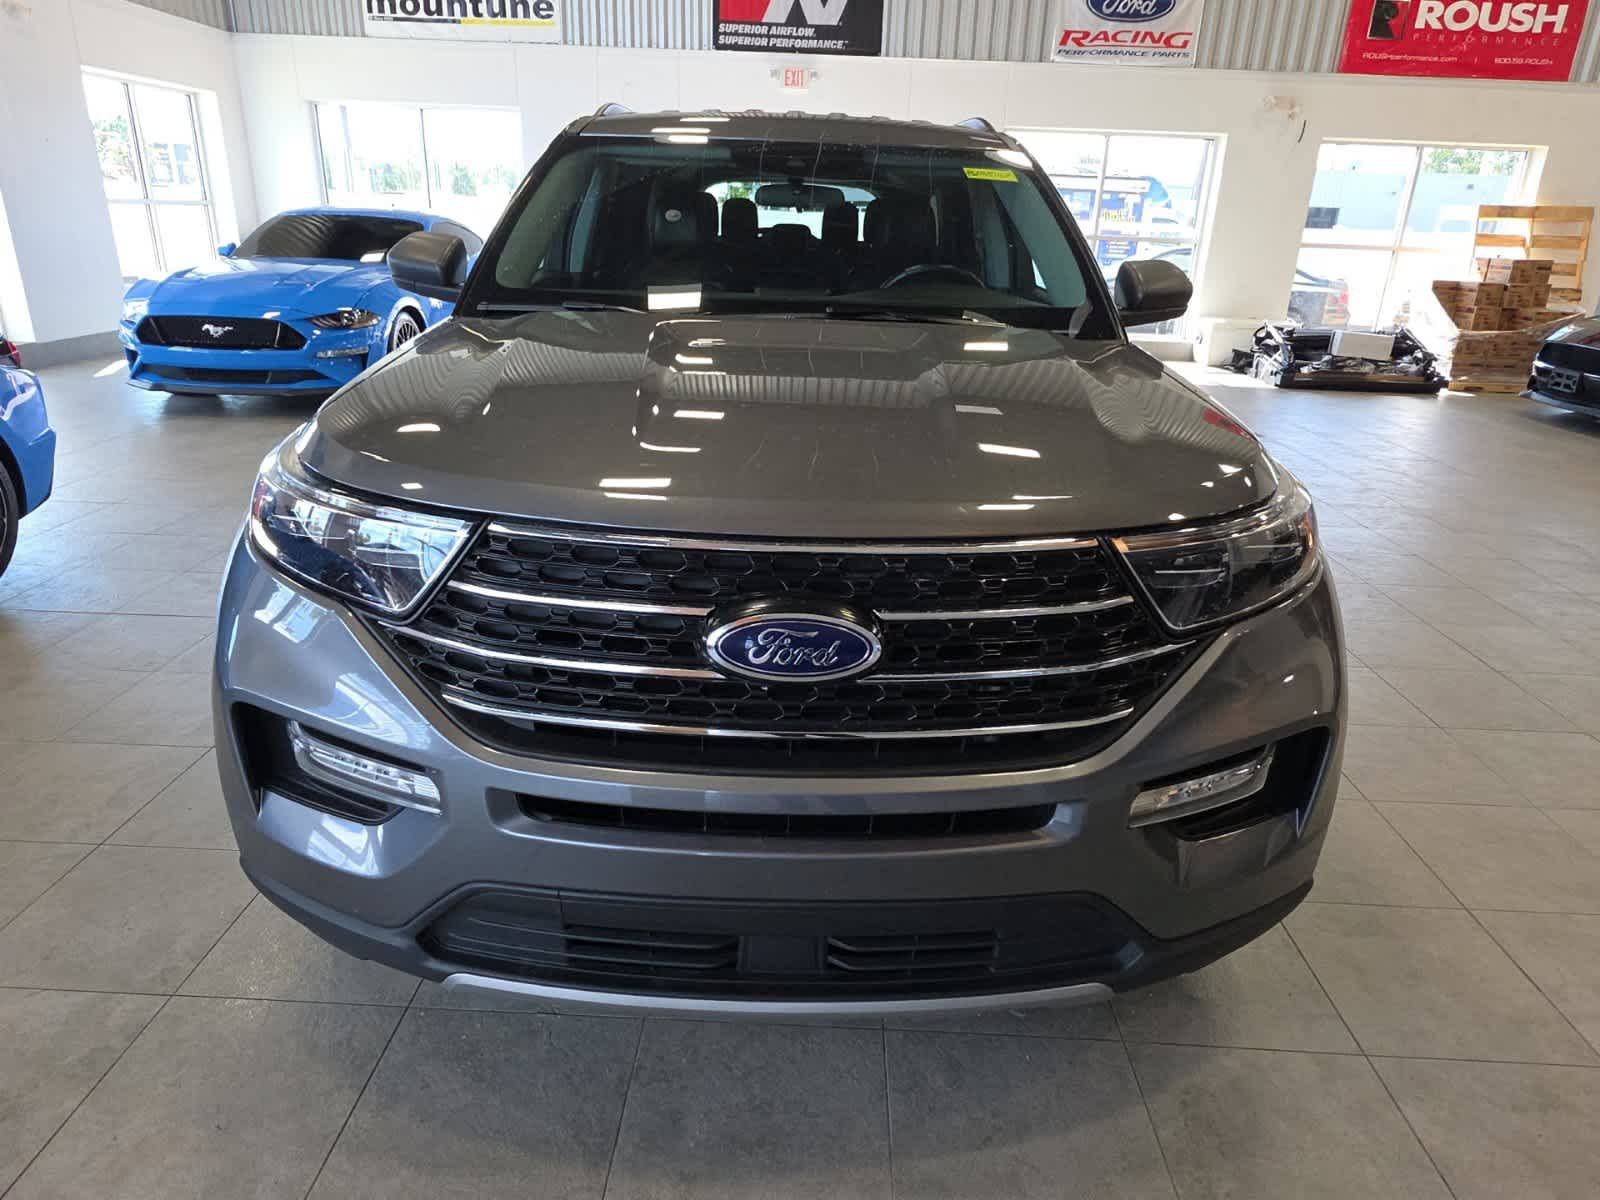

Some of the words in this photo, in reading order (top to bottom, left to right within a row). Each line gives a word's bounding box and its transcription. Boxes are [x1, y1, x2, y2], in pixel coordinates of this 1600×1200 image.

[366, 0, 554, 19] mountune
[1414, 0, 1568, 33] ROUSH
[718, 23, 768, 35] SUPERIOR
[769, 26, 816, 37] AIRFLOW.
[1058, 29, 1193, 49] RACING
[718, 35, 768, 46] SUPERIOR
[1057, 49, 1149, 57] PERFORMANCE
[784, 69, 805, 87] EXIT
[748, 628, 841, 667] Ford
